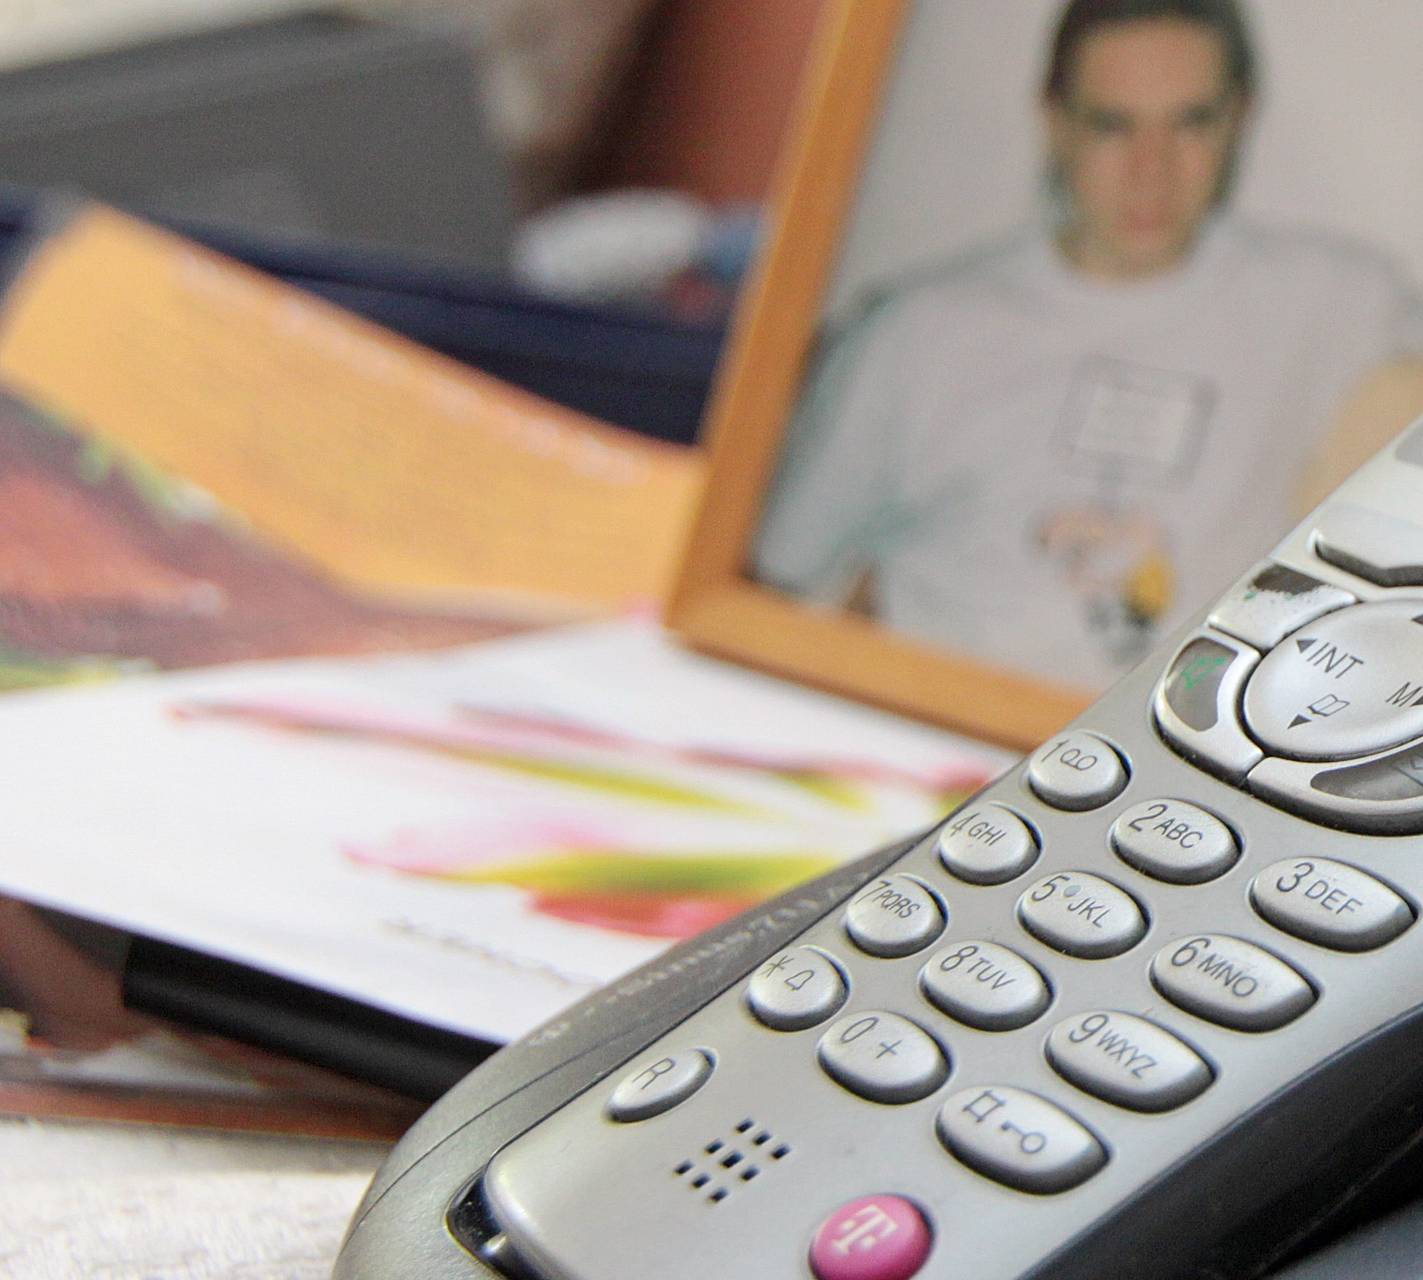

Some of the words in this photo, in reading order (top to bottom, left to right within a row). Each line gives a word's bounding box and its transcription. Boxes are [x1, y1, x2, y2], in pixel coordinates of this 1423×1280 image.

[1306, 643, 1364, 681] INT
[1386, 682, 1419, 709] M
[1041, 738, 1069, 763] 1
[967, 821, 1007, 846] GHI
[1153, 818, 1203, 848] ABC
[872, 890, 920, 919] PQRS
[1067, 897, 1113, 928] JKL
[1304, 879, 1363, 916] DEF
[966, 957, 1016, 991] TUV
[1199, 954, 1259, 998] MNO
[1096, 1029, 1158, 1079] WXYZ
[632, 1057, 676, 1090] R
